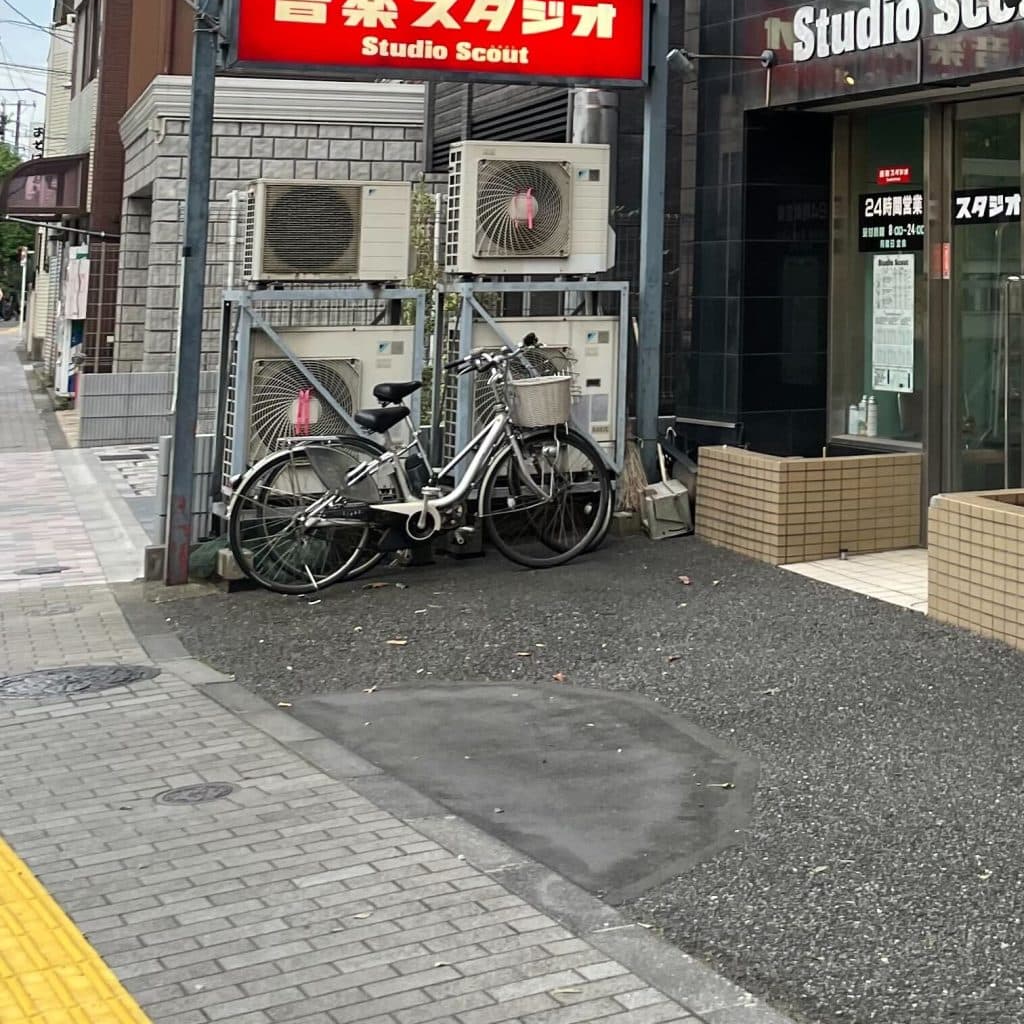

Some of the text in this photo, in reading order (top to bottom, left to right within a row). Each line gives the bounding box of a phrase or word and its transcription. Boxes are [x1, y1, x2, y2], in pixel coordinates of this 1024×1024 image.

[361, 36, 530, 65] Studio Scout
[956, 193, 1022, 219] スタジオ
